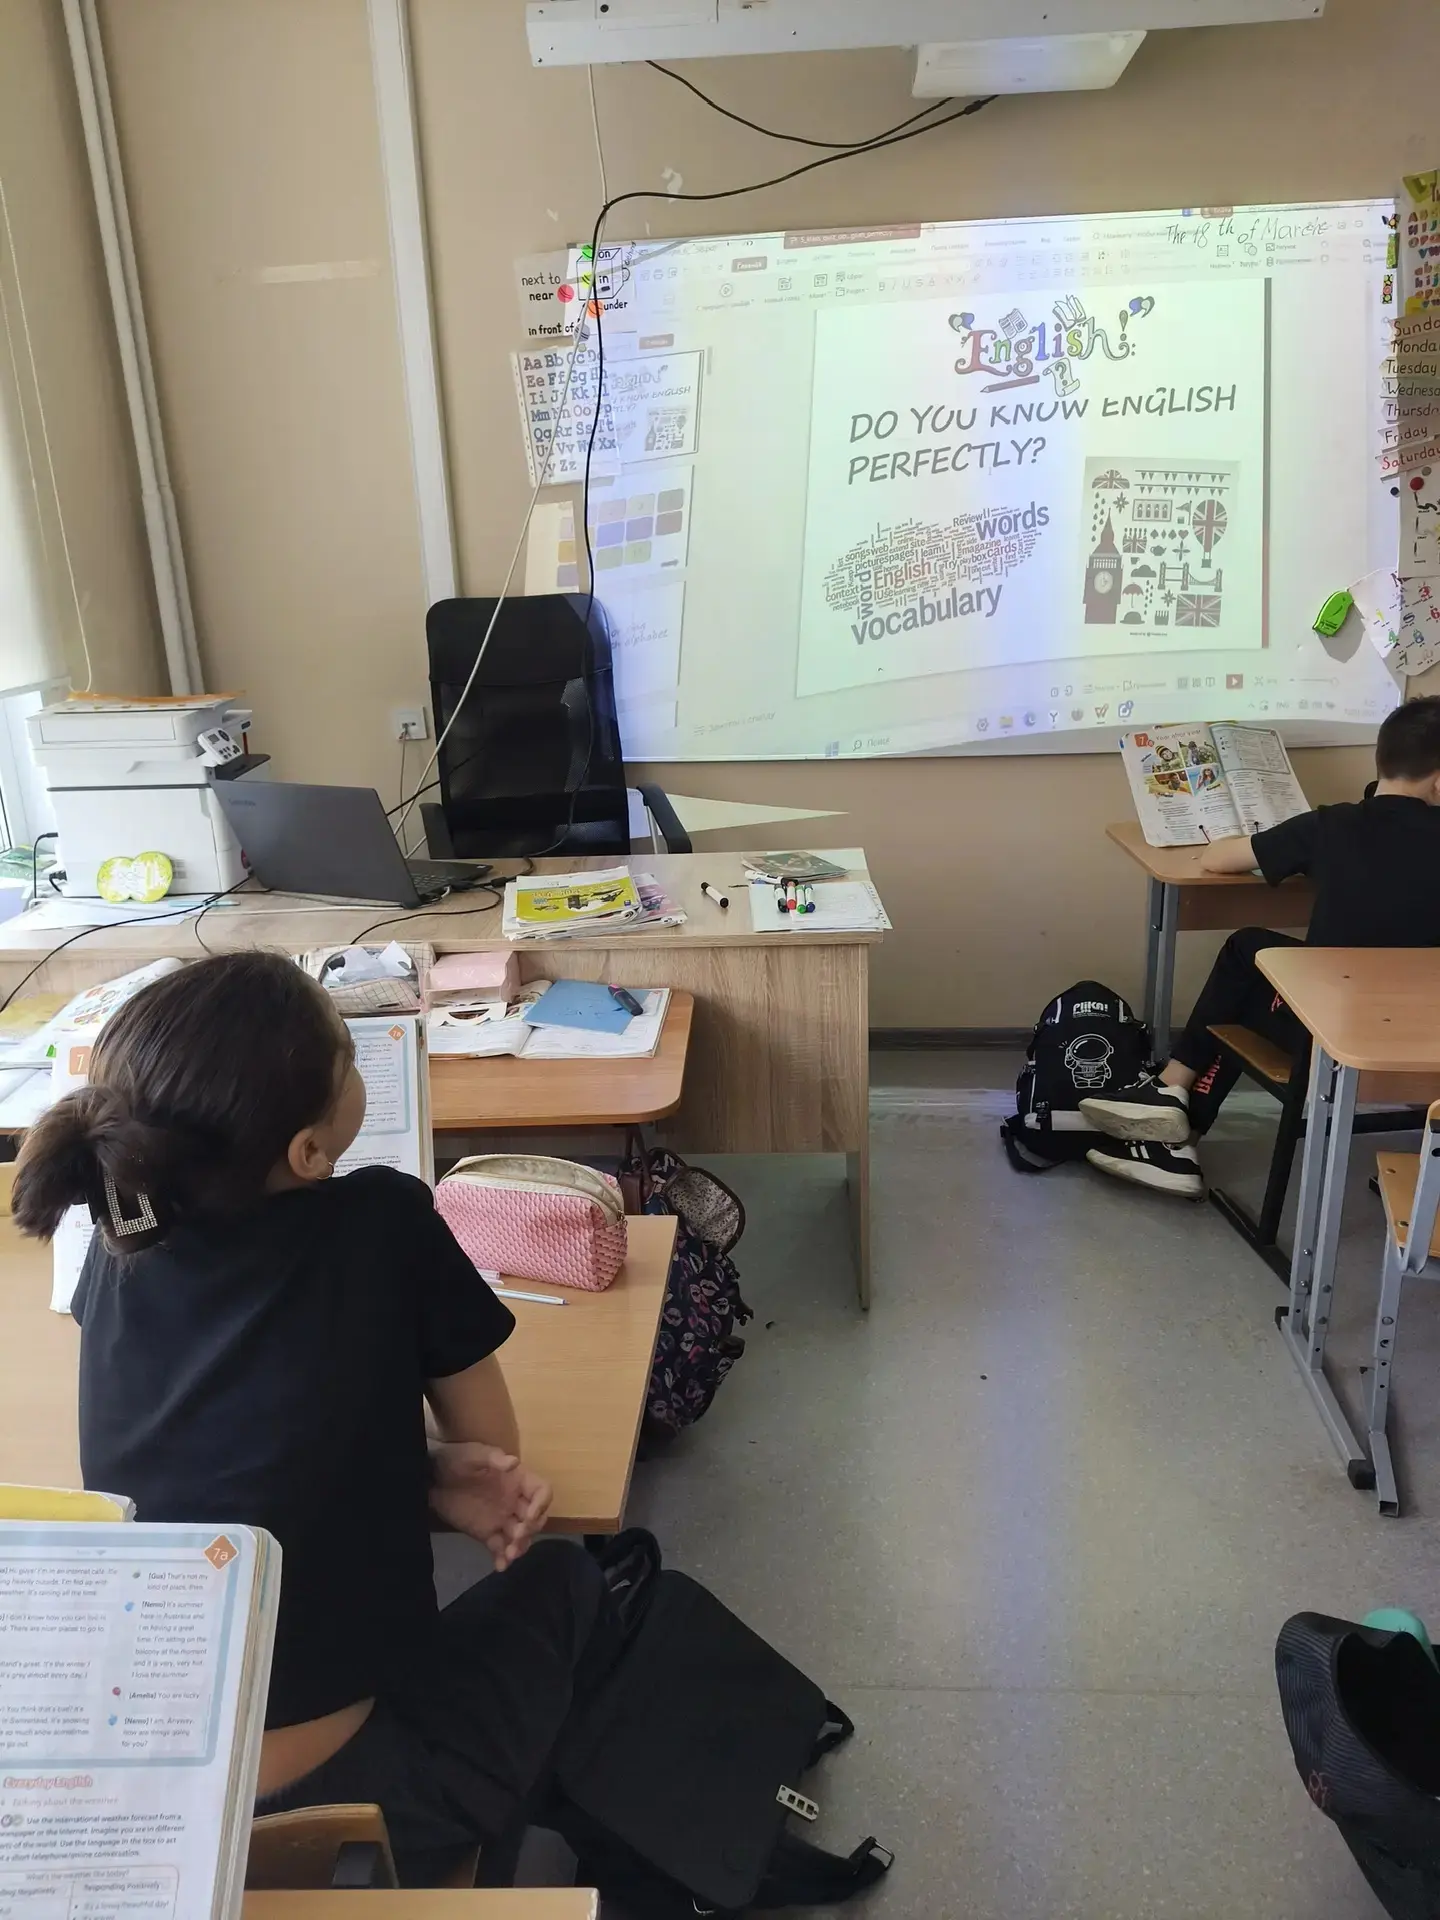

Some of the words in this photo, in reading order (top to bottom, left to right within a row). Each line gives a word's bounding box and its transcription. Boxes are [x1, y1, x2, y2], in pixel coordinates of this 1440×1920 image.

[1218, 217, 1235, 237] th
[1237, 218, 1260, 244] of
[598, 250, 611, 259] on
[521, 272, 546, 287] next
[548, 271, 561, 285] to
[598, 274, 609, 285] in
[529, 291, 554, 301] near
[603, 300, 629, 311] under
[528, 327, 537, 337] in
[539, 322, 562, 335] front
[564, 321, 575, 333] of
[1391, 339, 1440, 354] Monda
[523, 357, 543, 371] Aa
[545, 353, 564, 368] Bb
[1386, 359, 1438, 377] Tuesday
[526, 374, 545, 389] Ee
[547, 371, 566, 386] Ff
[569, 370, 587, 385] Gg
[530, 391, 548, 405] Ii
[571, 386, 590, 401] Kk
[531, 409, 551, 423] Mm
[573, 404, 592, 417] Oo
[848, 410, 899, 445] DO
[910, 403, 977, 434] YOU
[988, 397, 1090, 428] KNOW
[1100, 383, 1238, 418] ENGLISH
[1385, 427, 1428, 444] Friday
[846, 436, 1048, 486] PERFECTLY?
[953, 513, 983, 528] Review
[975, 501, 1050, 541] words
[870, 543, 889, 557] web
[910, 538, 926, 549] site
[962, 539, 1002, 555] magazine
[986, 541, 1018, 558] cards
[844, 549, 871, 563] songs
[854, 555, 889, 574] pictures
[888, 549, 915, 564] pages
[971, 552, 987, 563] box
[873, 557, 932, 590] English
[944, 560, 958, 571] Try
[825, 584, 860, 602] context
[854, 570, 874, 620] word
[850, 584, 1004, 646] vocabulary
[77, 1053, 85, 1072] 7
[211, 1547, 229, 1562] 7a
